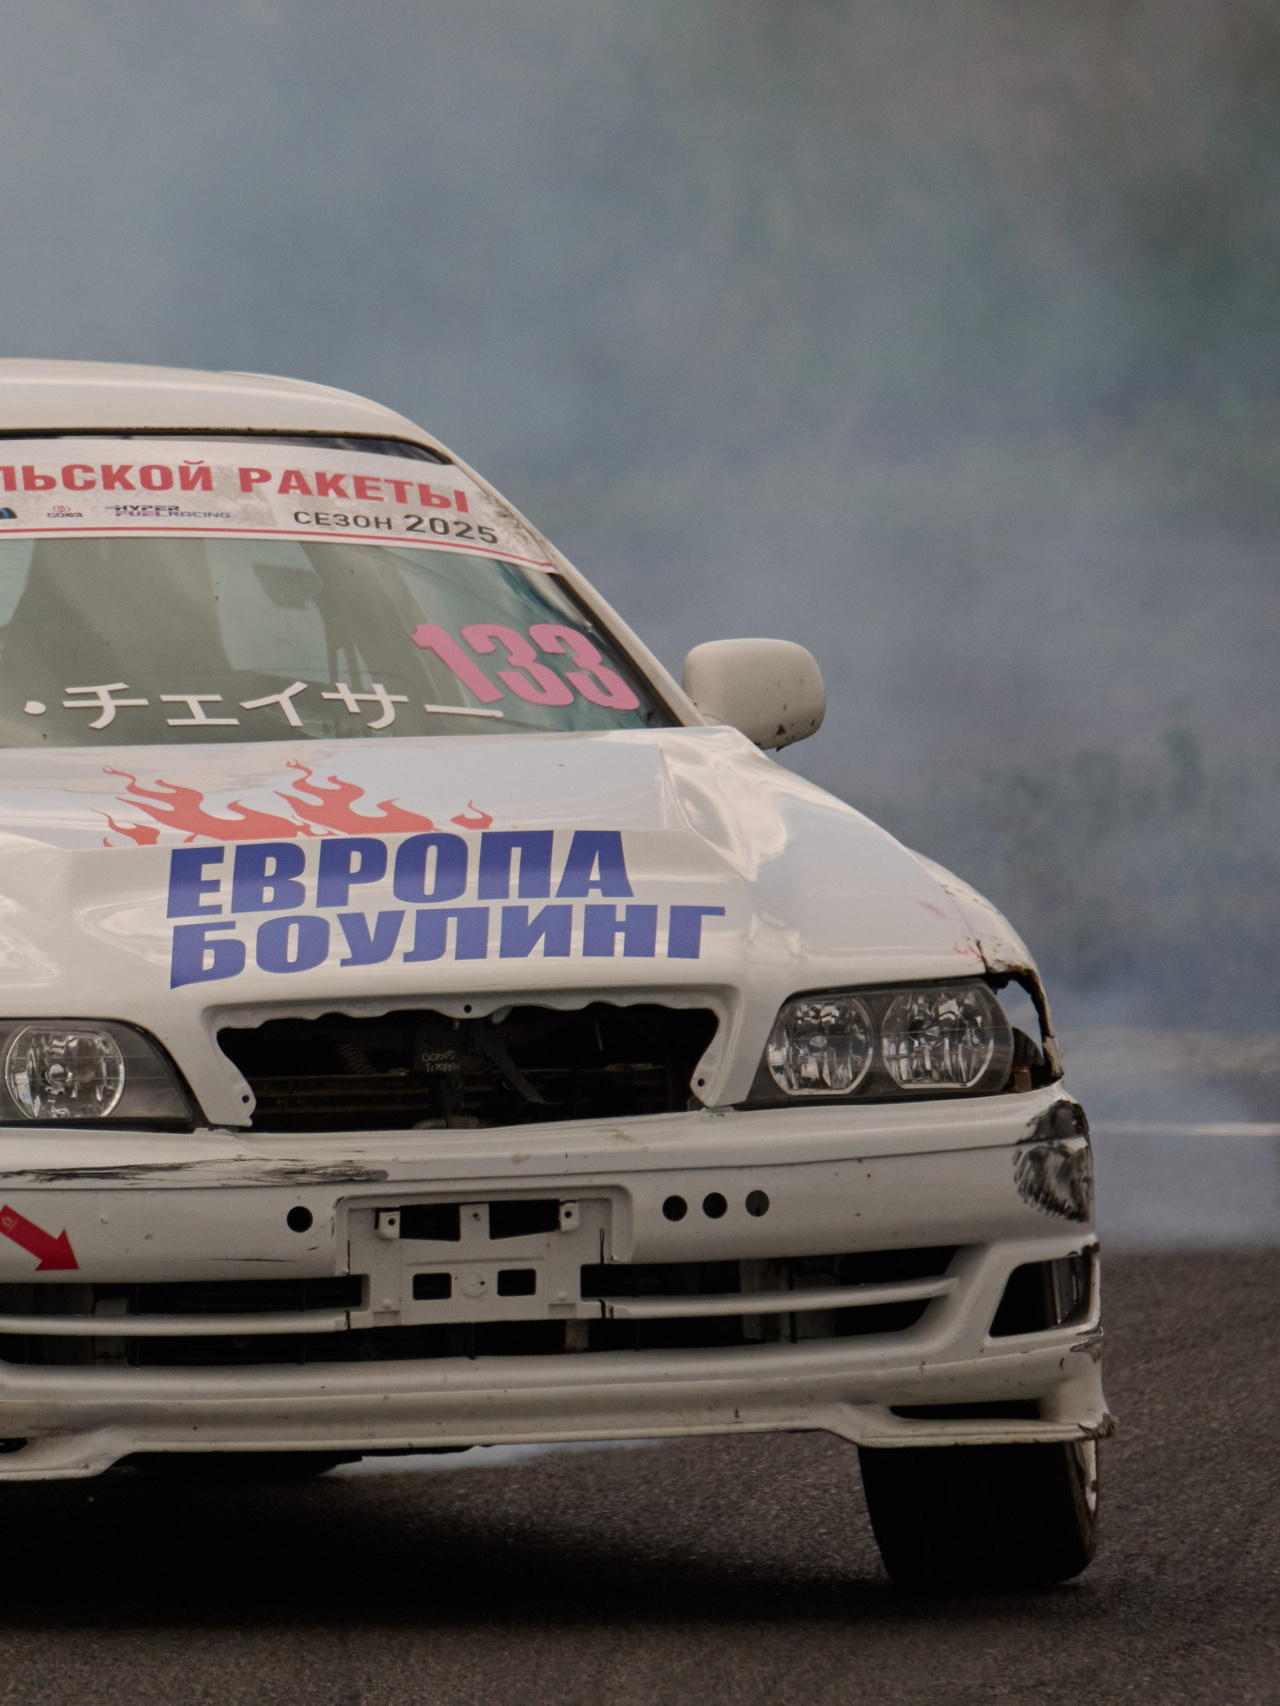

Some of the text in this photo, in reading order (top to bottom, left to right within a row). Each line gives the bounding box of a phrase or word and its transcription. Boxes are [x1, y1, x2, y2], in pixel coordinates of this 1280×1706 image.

[115, 504, 181, 512] HYPER
[238, 466, 470, 514] РАКЕТЫ
[293, 510, 499, 545] СЕЗОН 2025
[411, 622, 641, 711] 133
[166, 829, 635, 919] ЕВРОПА
[170, 903, 726, 990] БОУЛИНГ
